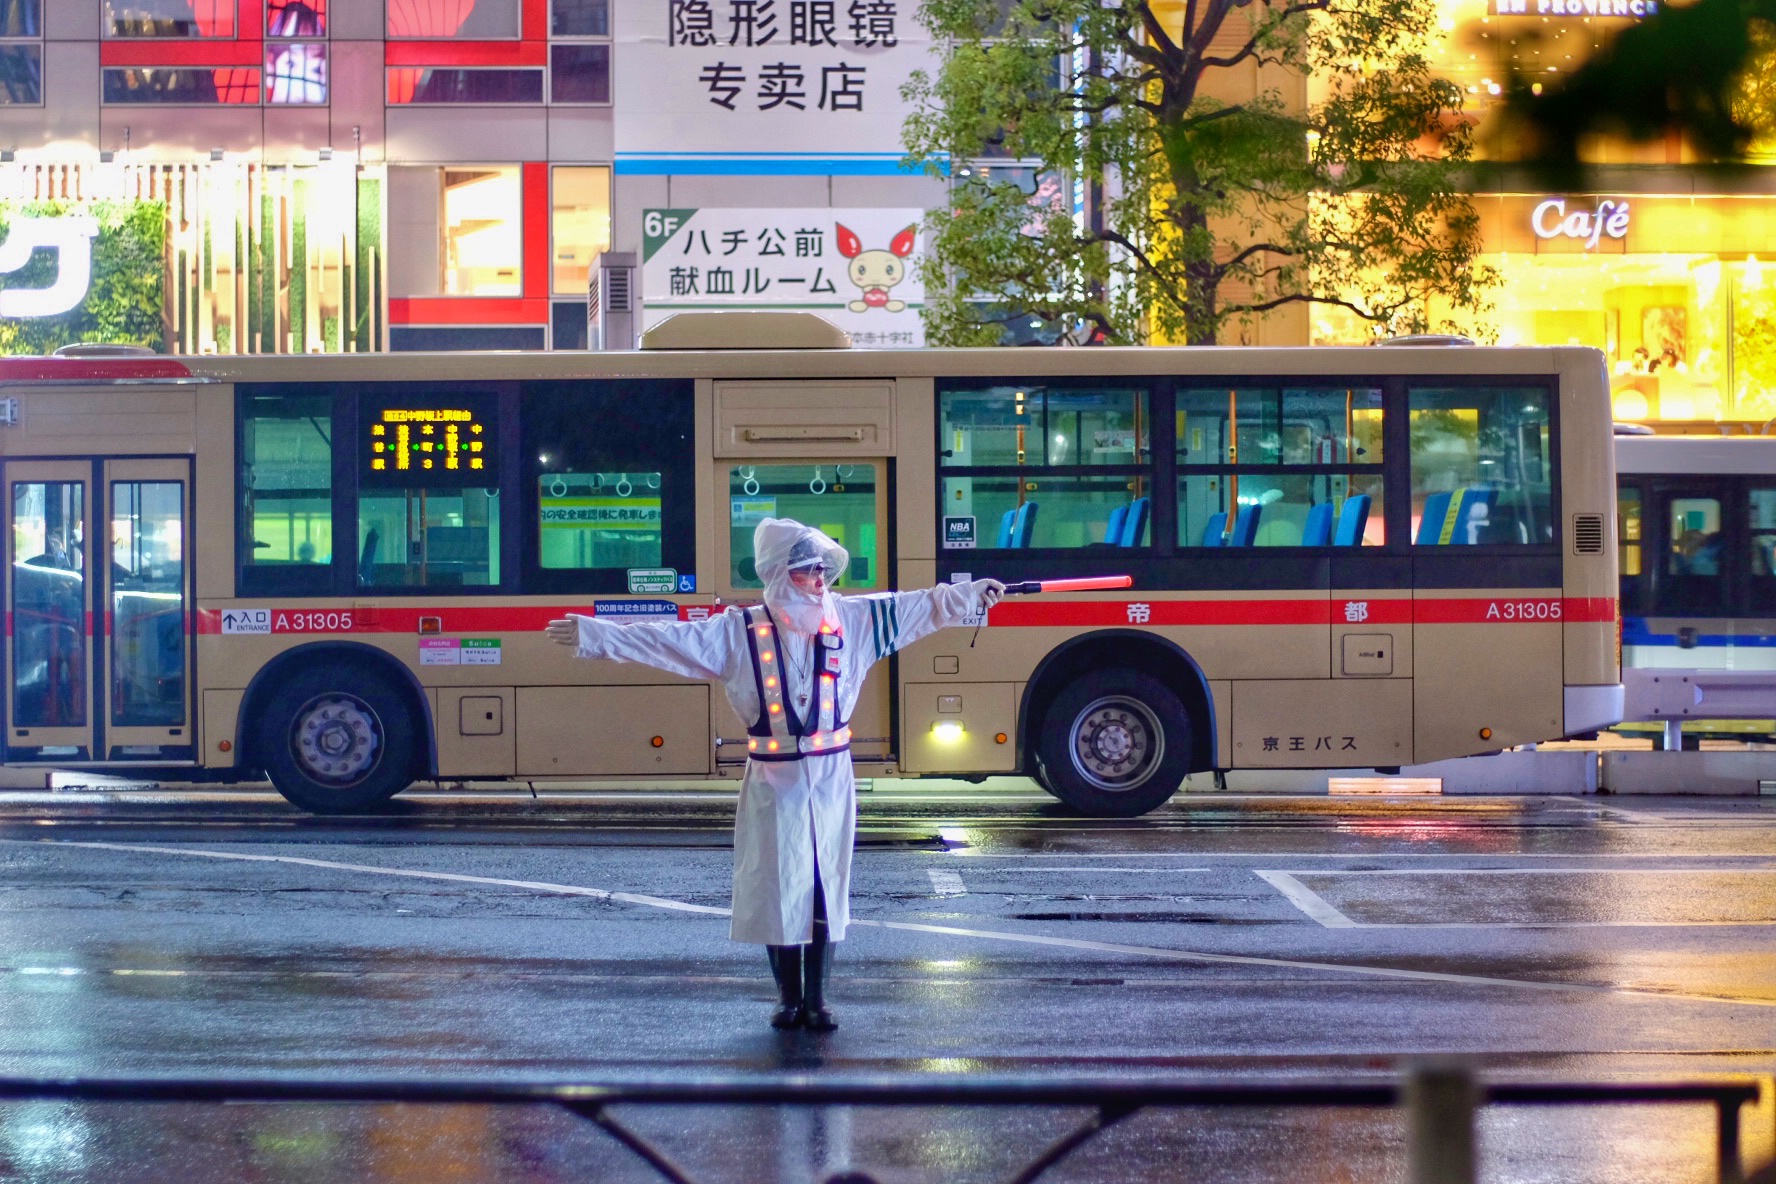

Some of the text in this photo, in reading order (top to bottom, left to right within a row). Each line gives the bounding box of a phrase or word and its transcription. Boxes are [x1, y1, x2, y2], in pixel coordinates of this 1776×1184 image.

[668, 0, 899, 48] 隐形眼镜
[698, 61, 867, 112] 专卖店
[644, 211, 679, 238] 6F
[1531, 199, 1630, 250] Café
[683, 227, 824, 258] ハチ公前
[669, 266, 837, 296] 献血ルーム
[847, 331, 914, 345] 本赤十字社
[541, 509, 662, 520] の安全確認後に発車しま
[949, 522, 970, 532] NBA
[240, 611, 266, 623] 入口
[595, 603, 677, 612] 100周年記念旧塗装バス
[1127, 603, 1150, 624] 帝
[1344, 602, 1368, 622] 都
[1262, 736, 1357, 751] 京王バス
